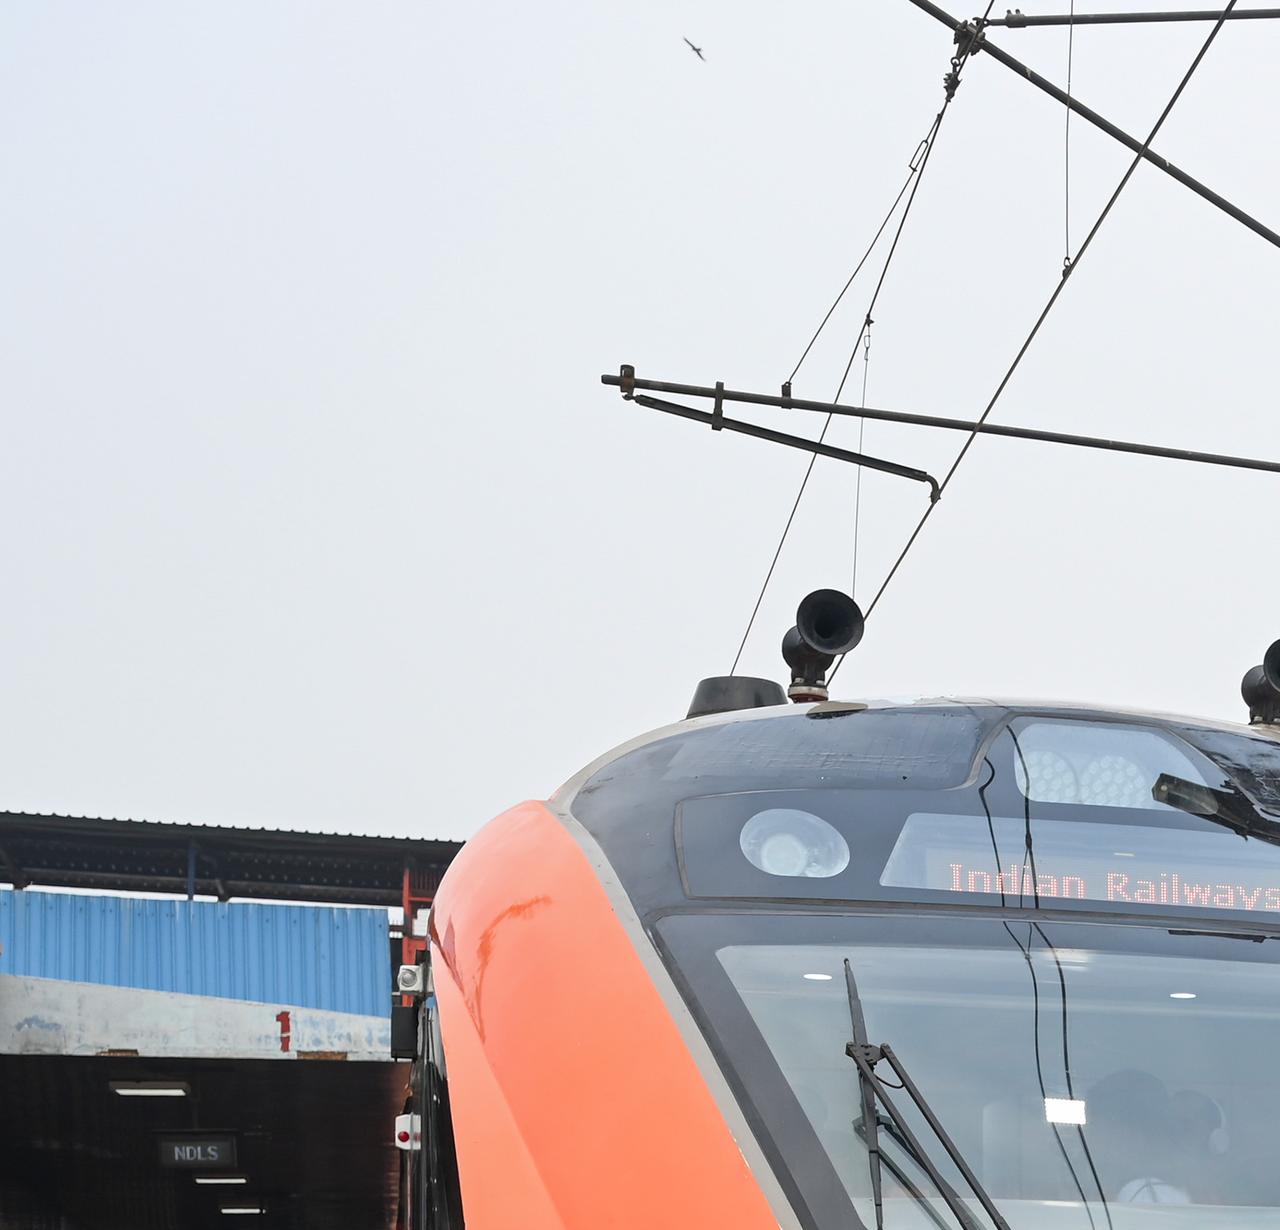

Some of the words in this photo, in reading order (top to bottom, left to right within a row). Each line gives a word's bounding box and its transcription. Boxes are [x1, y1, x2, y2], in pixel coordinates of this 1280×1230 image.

[949, 863, 1086, 899] Indian
[275, 1010, 291, 1053] 1
[174, 1146, 219, 1161] NDLS
